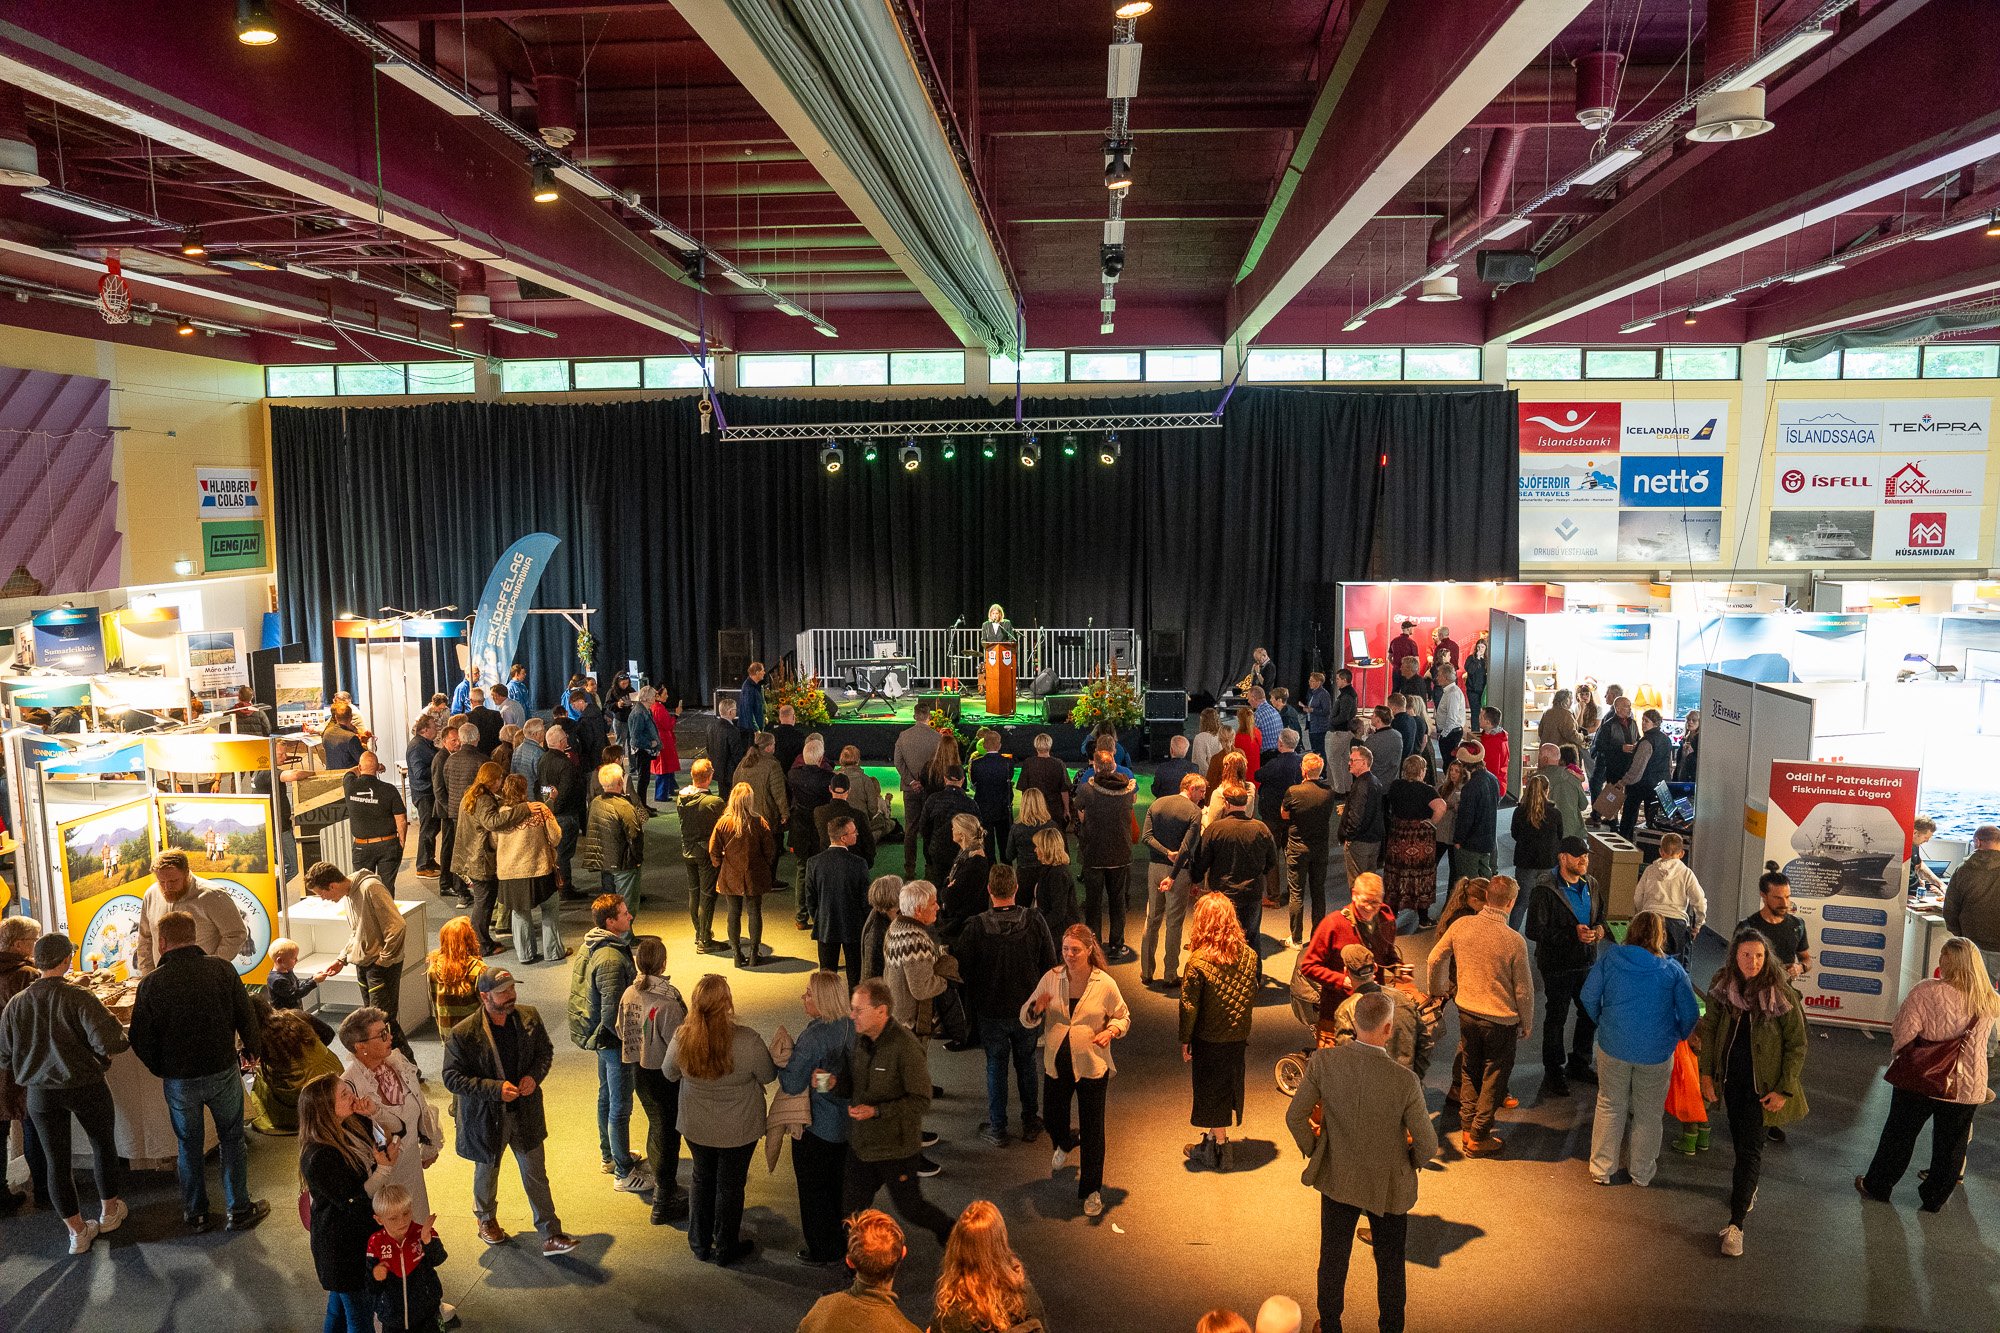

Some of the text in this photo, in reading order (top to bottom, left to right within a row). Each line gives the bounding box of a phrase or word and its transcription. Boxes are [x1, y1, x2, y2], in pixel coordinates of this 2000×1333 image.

[1626, 426, 1690, 435] ICELANDAIR
[1889, 422, 1982, 432] TEMPRA
[1538, 435, 1611, 447] Íslandsbanki
[1786, 427, 1875, 444] ÍSLANDSSAGA
[1812, 475, 1872, 487] ÍSFELL
[217, 494, 244, 507] COLAS
[1533, 546, 1559, 556] ORKUBÚ
[496, 556, 534, 649] STRANDAMANNA
[1785, 771, 1813, 782] Oddi
[1814, 773, 1827, 782] hf
[1836, 775, 1903, 788] Patreksfirði
[1792, 785, 1847, 797] Fiskvinnsla
[1857, 788, 1891, 800] Útgerð
[1804, 994, 1841, 1008] oddi
[380, 1244, 393, 1255] 23
